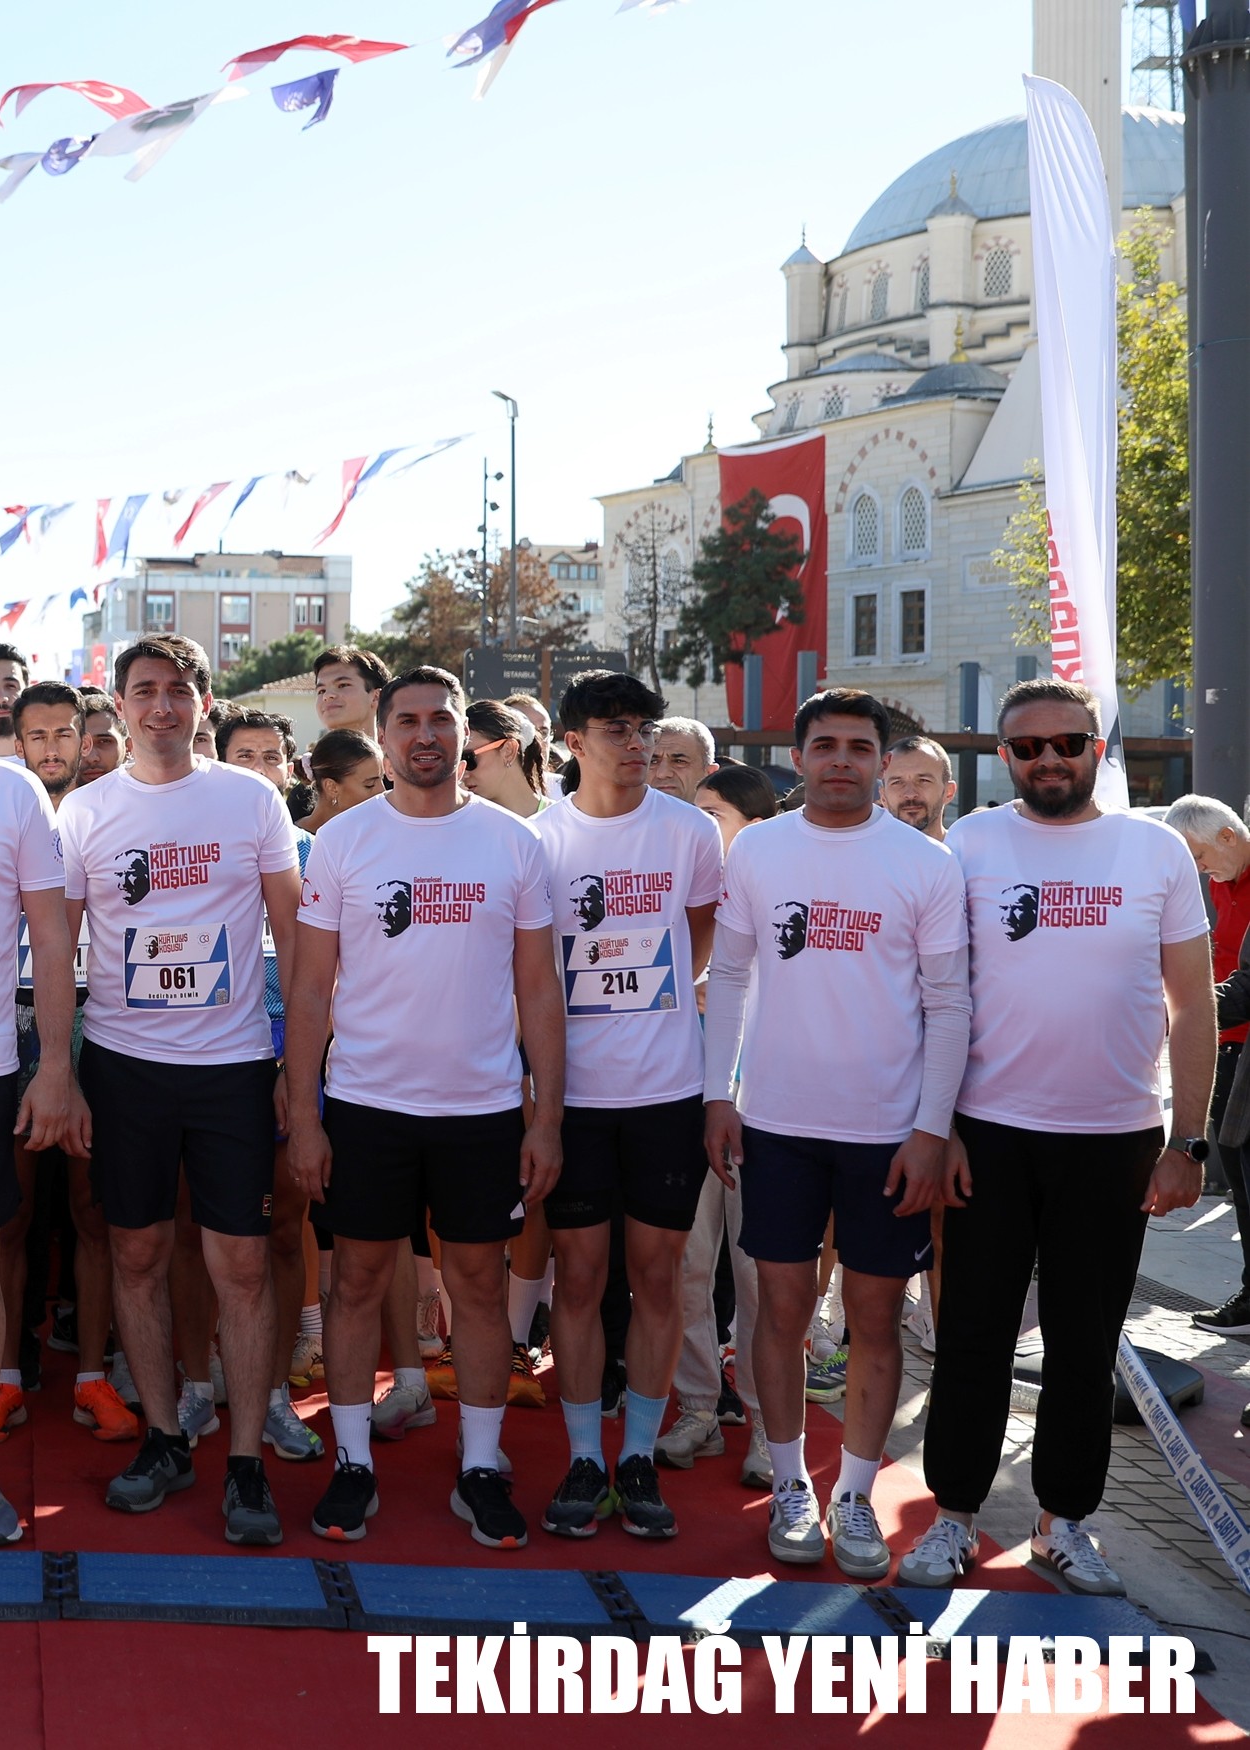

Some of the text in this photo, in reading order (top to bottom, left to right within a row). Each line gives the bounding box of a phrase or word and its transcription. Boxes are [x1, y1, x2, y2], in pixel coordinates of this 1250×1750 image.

[150, 842, 221, 865] KURTULUŞ
[150, 865, 210, 891] KOŞUSU
[604, 872, 673, 896] KURTULUŞ
[413, 882, 486, 904] KURTULUŞ
[605, 893, 662, 917] KOŞUSU
[1040, 886, 1123, 907] KURTULUŞ
[412, 903, 472, 926] KOŞUSU
[808, 906, 883, 934] KURTULUŞ
[1038, 906, 1107, 929] KOŞUSU
[806, 928, 865, 952] KOŞUSU
[159, 966, 197, 990] 061
[601, 970, 639, 995] 214
[1165, 1435, 1190, 1469] ZABITA
[1190, 1473, 1217, 1511] ZABITA
[1213, 1511, 1243, 1550] ZABITA
